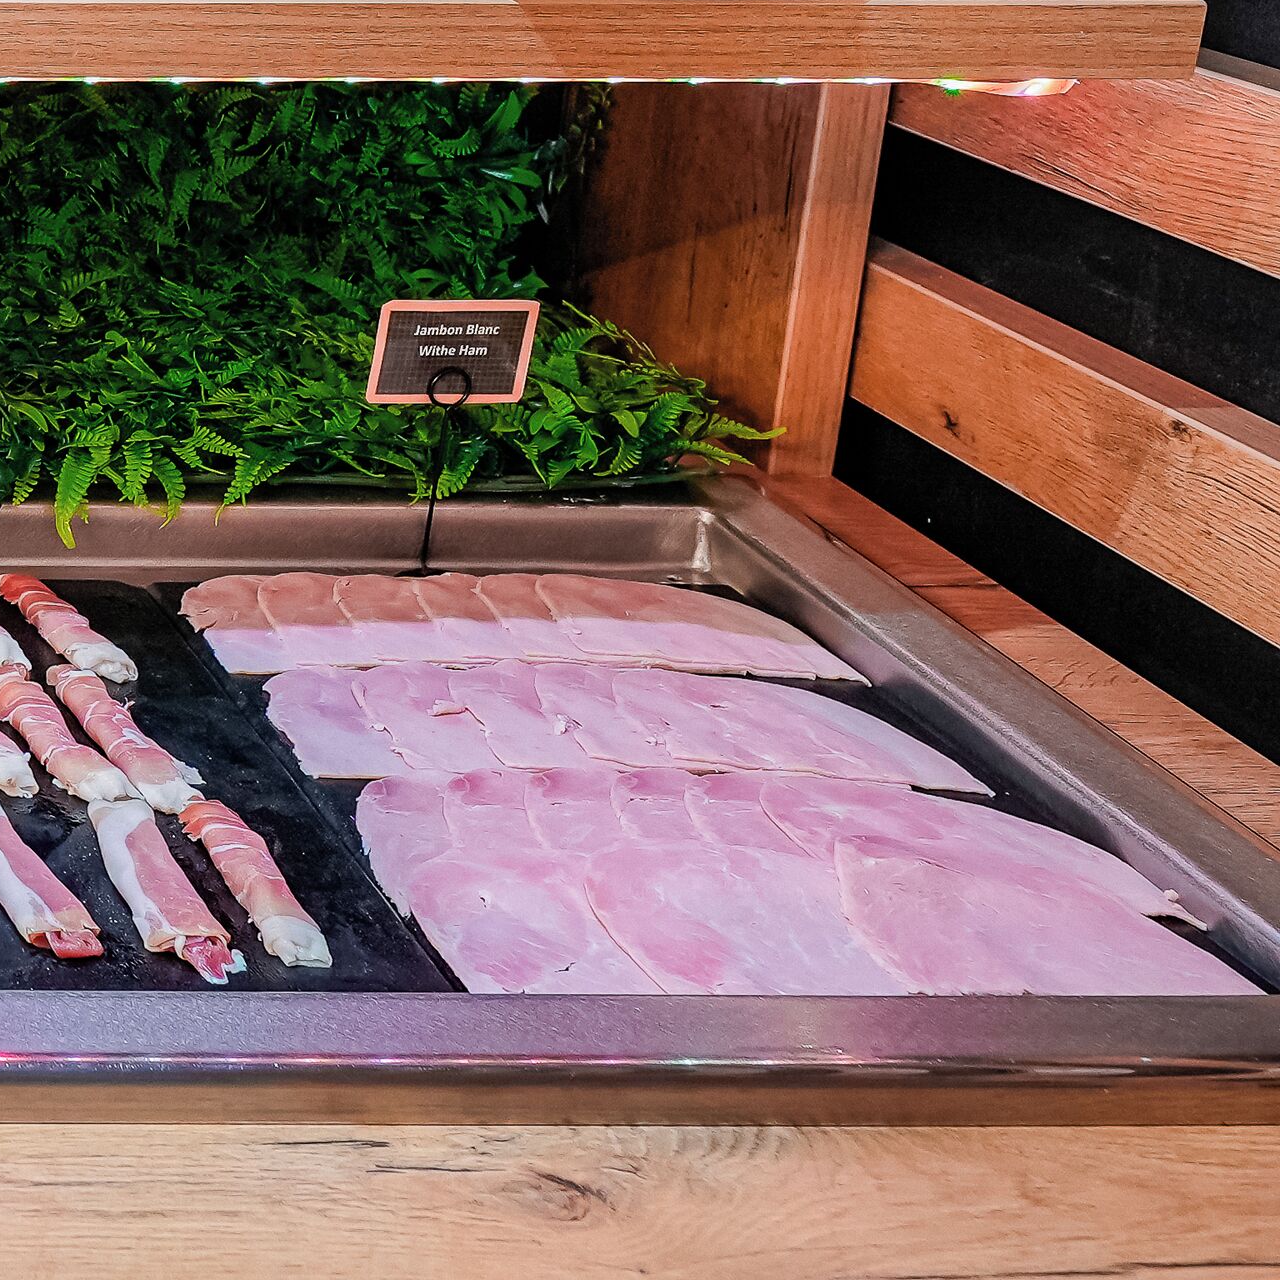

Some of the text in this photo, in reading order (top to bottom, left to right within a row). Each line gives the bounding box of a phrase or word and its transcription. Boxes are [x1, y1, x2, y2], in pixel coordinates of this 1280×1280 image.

[413, 323, 501, 337] Jambon Blanc
[418, 344, 488, 357] Withe Ham
